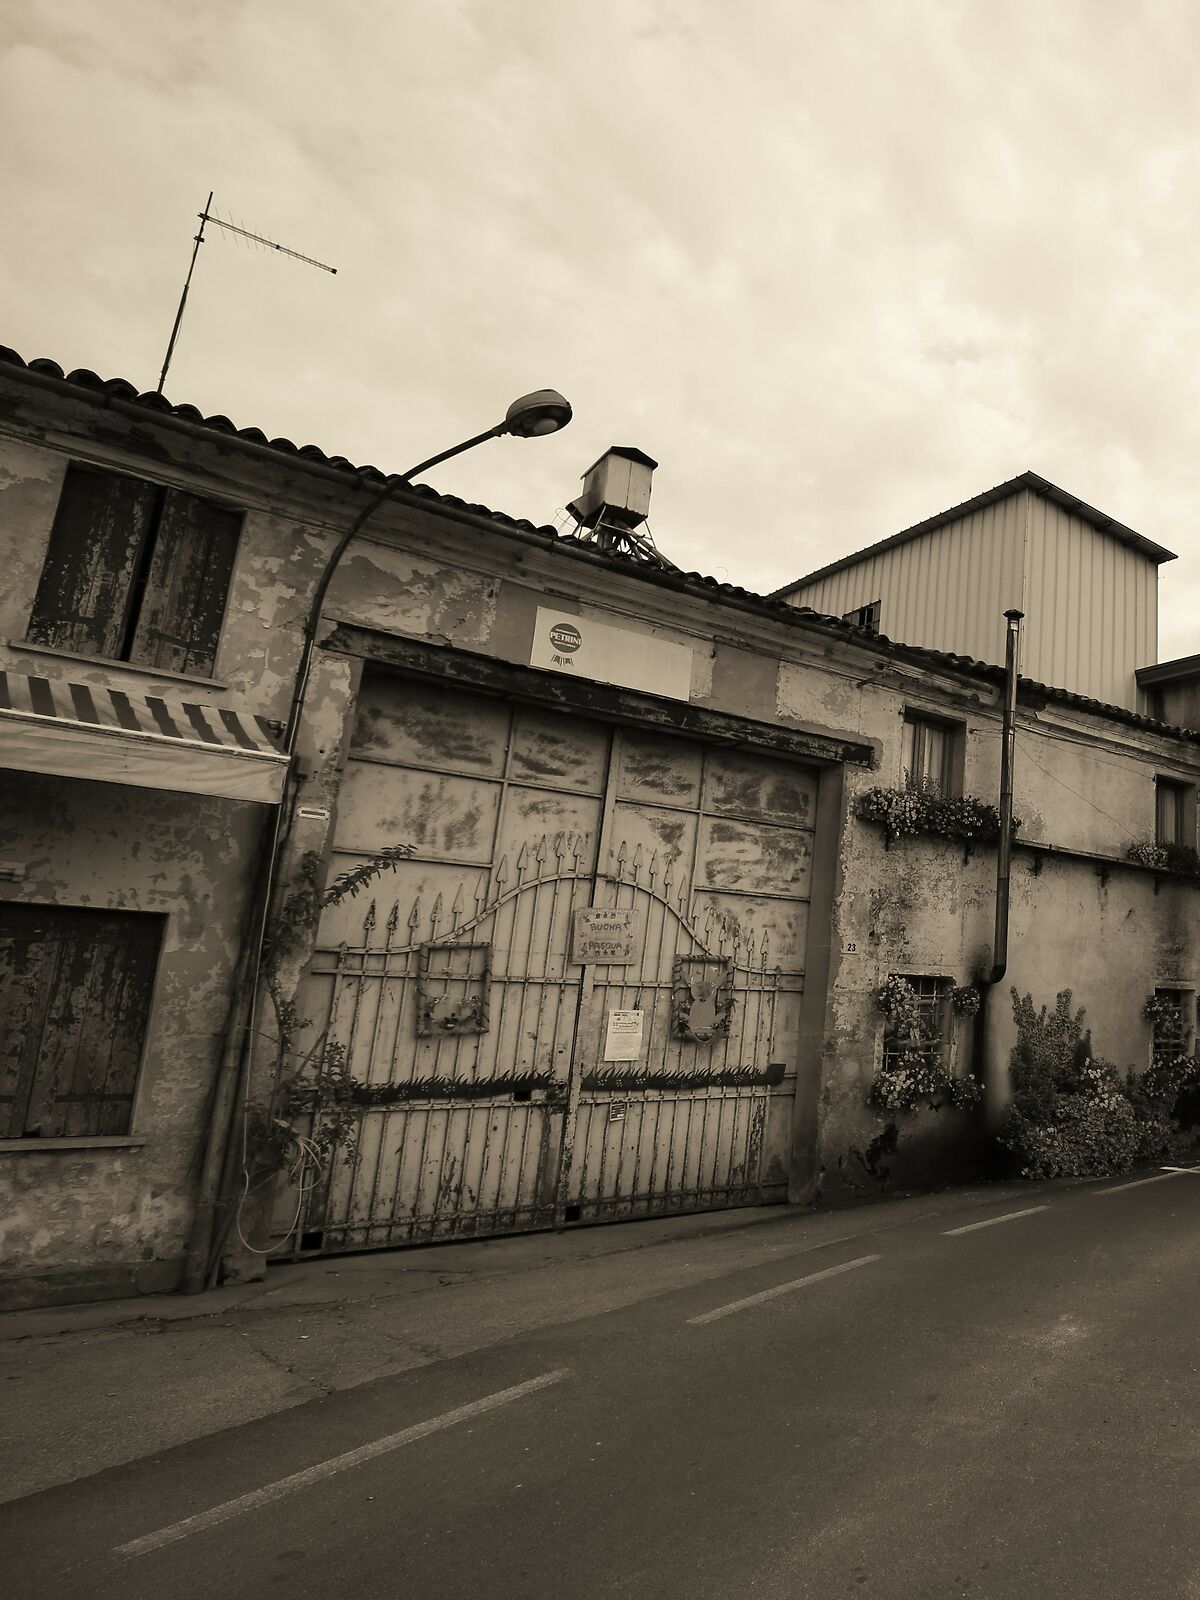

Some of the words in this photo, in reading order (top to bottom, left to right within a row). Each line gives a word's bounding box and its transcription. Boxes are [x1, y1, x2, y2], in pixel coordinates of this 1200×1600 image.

[550, 631, 582, 645] PETRINI
[590, 923, 622, 931] BUONA
[588, 941, 622, 951] PASQUA
[847, 943, 856, 952] 23
